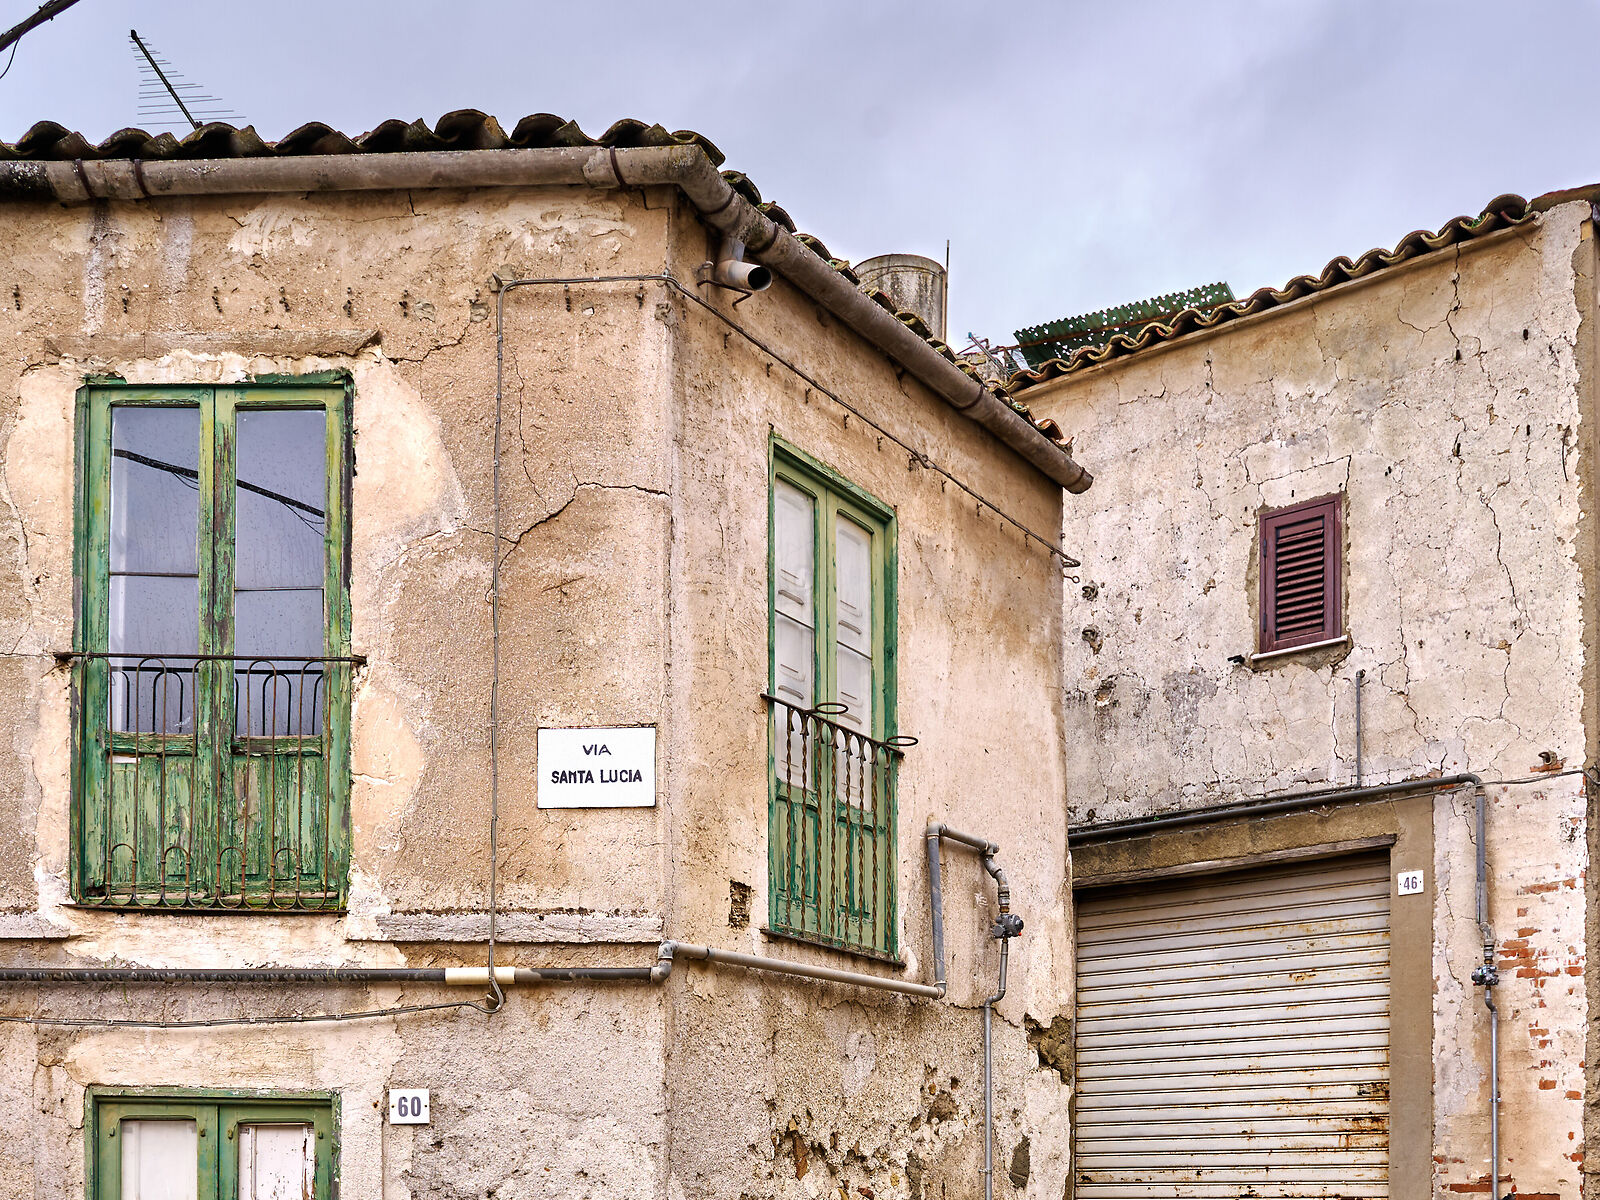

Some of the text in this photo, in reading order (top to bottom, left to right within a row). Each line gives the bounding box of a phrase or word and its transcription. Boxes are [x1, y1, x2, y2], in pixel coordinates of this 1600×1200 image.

[582, 744, 612, 756] VIA
[551, 769, 643, 784] SANTA LUCIA
[1404, 876, 1418, 890] 46
[398, 1096, 421, 1117] 60
